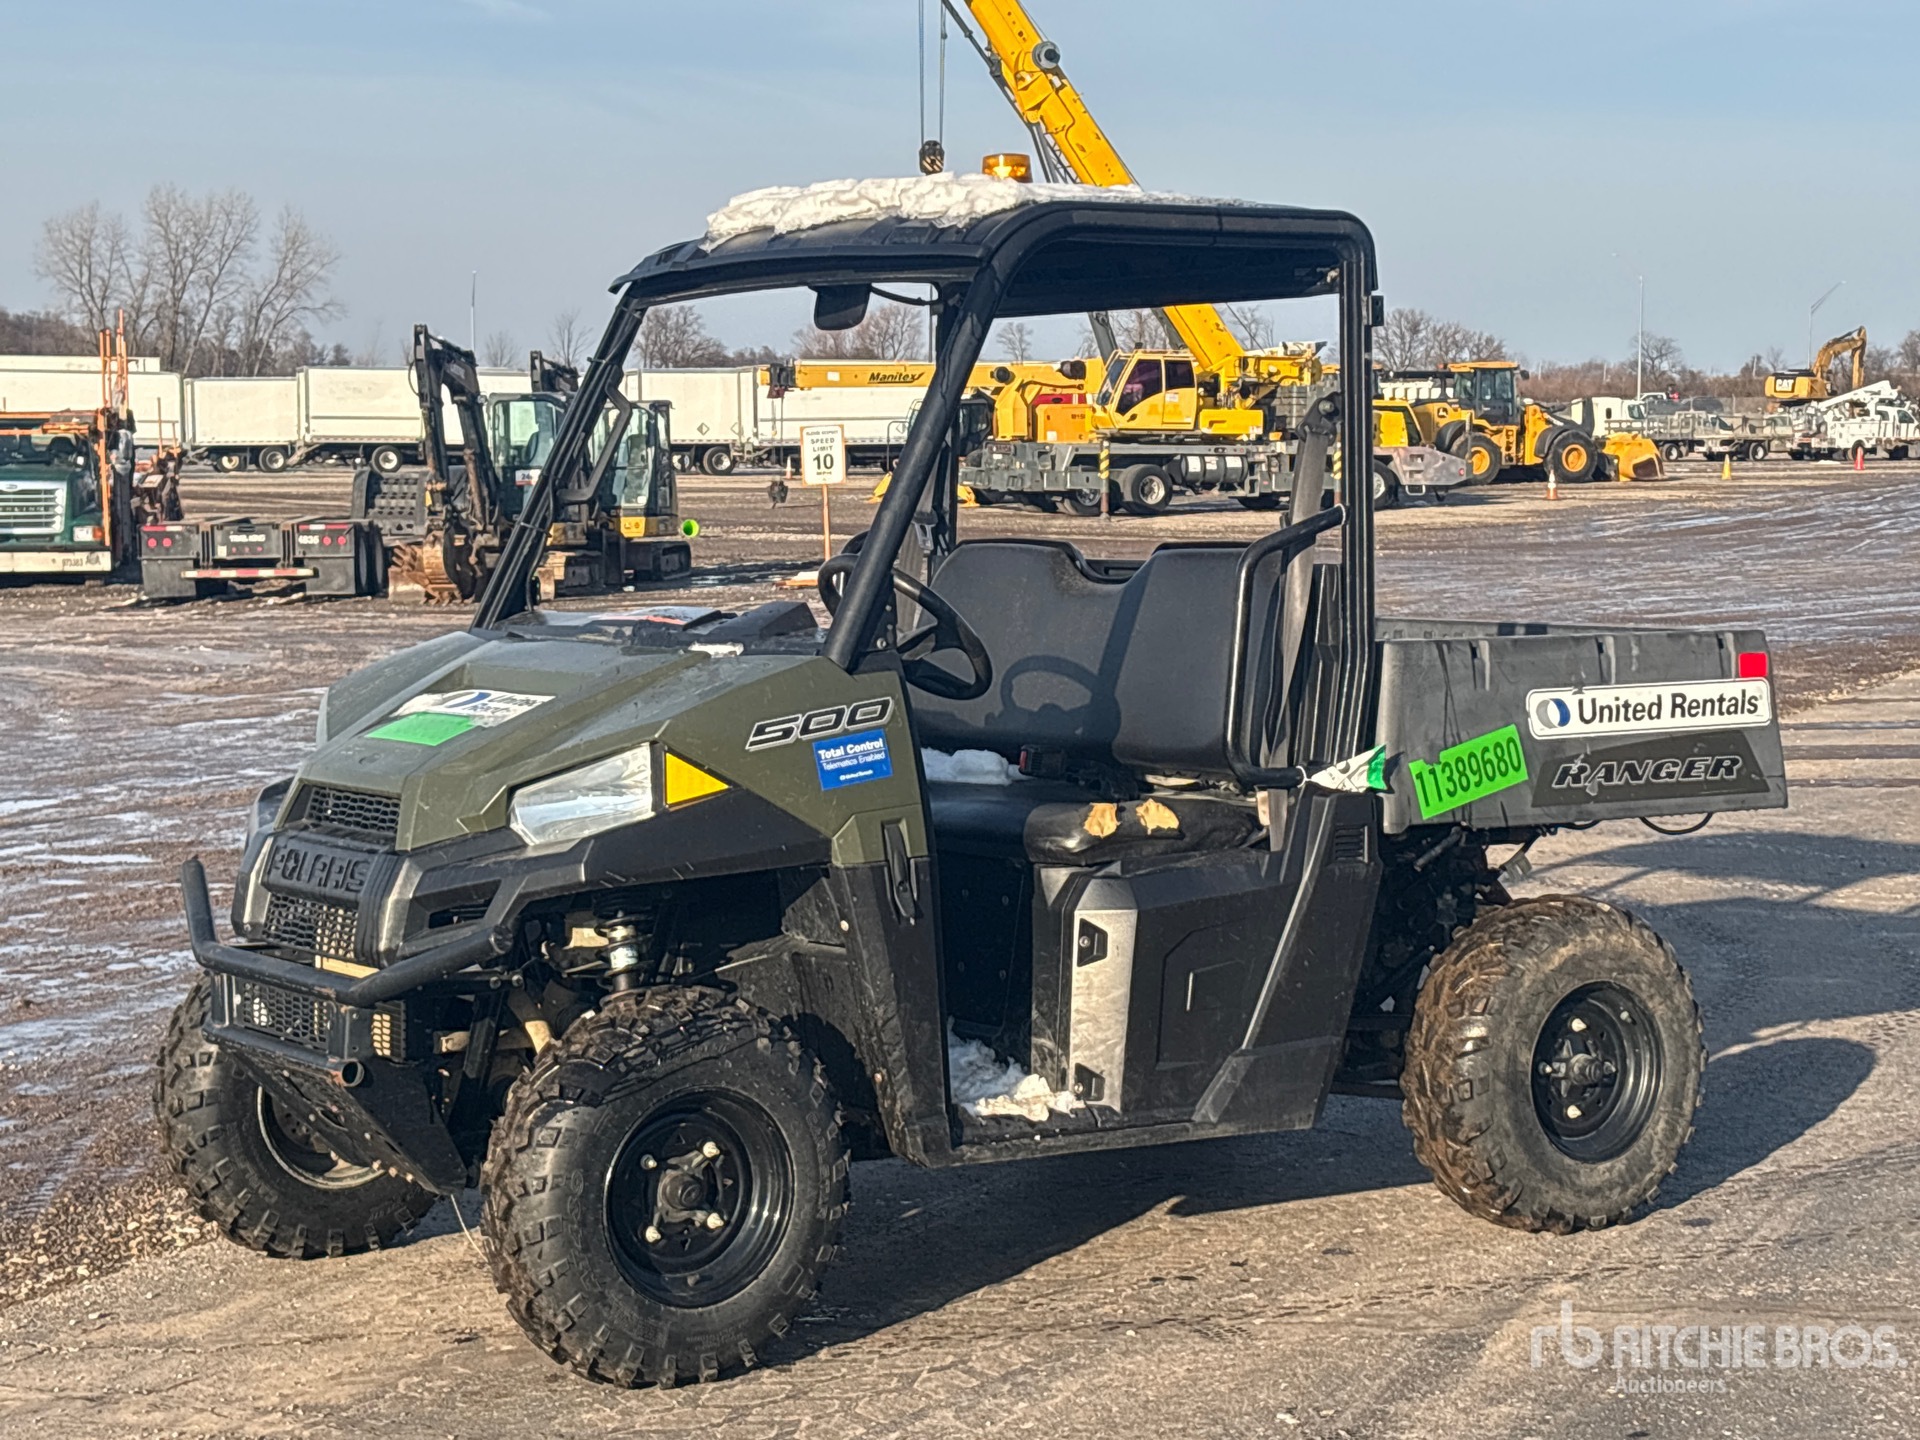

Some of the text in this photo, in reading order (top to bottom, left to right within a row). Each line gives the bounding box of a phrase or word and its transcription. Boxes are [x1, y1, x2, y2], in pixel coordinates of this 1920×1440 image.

[868, 371, 921, 384] Manitex
[1776, 379, 1794, 390] CAT
[812, 453, 834, 470] 10
[1577, 689, 1759, 725] United Rentals
[745, 696, 894, 752] 500
[818, 737, 884, 760] Total Control
[822, 751, 886, 771] Telematics Enabled
[1415, 736, 1522, 807] 11389680
[1552, 755, 1743, 789] RANGER
[267, 841, 371, 893] POLARIS
